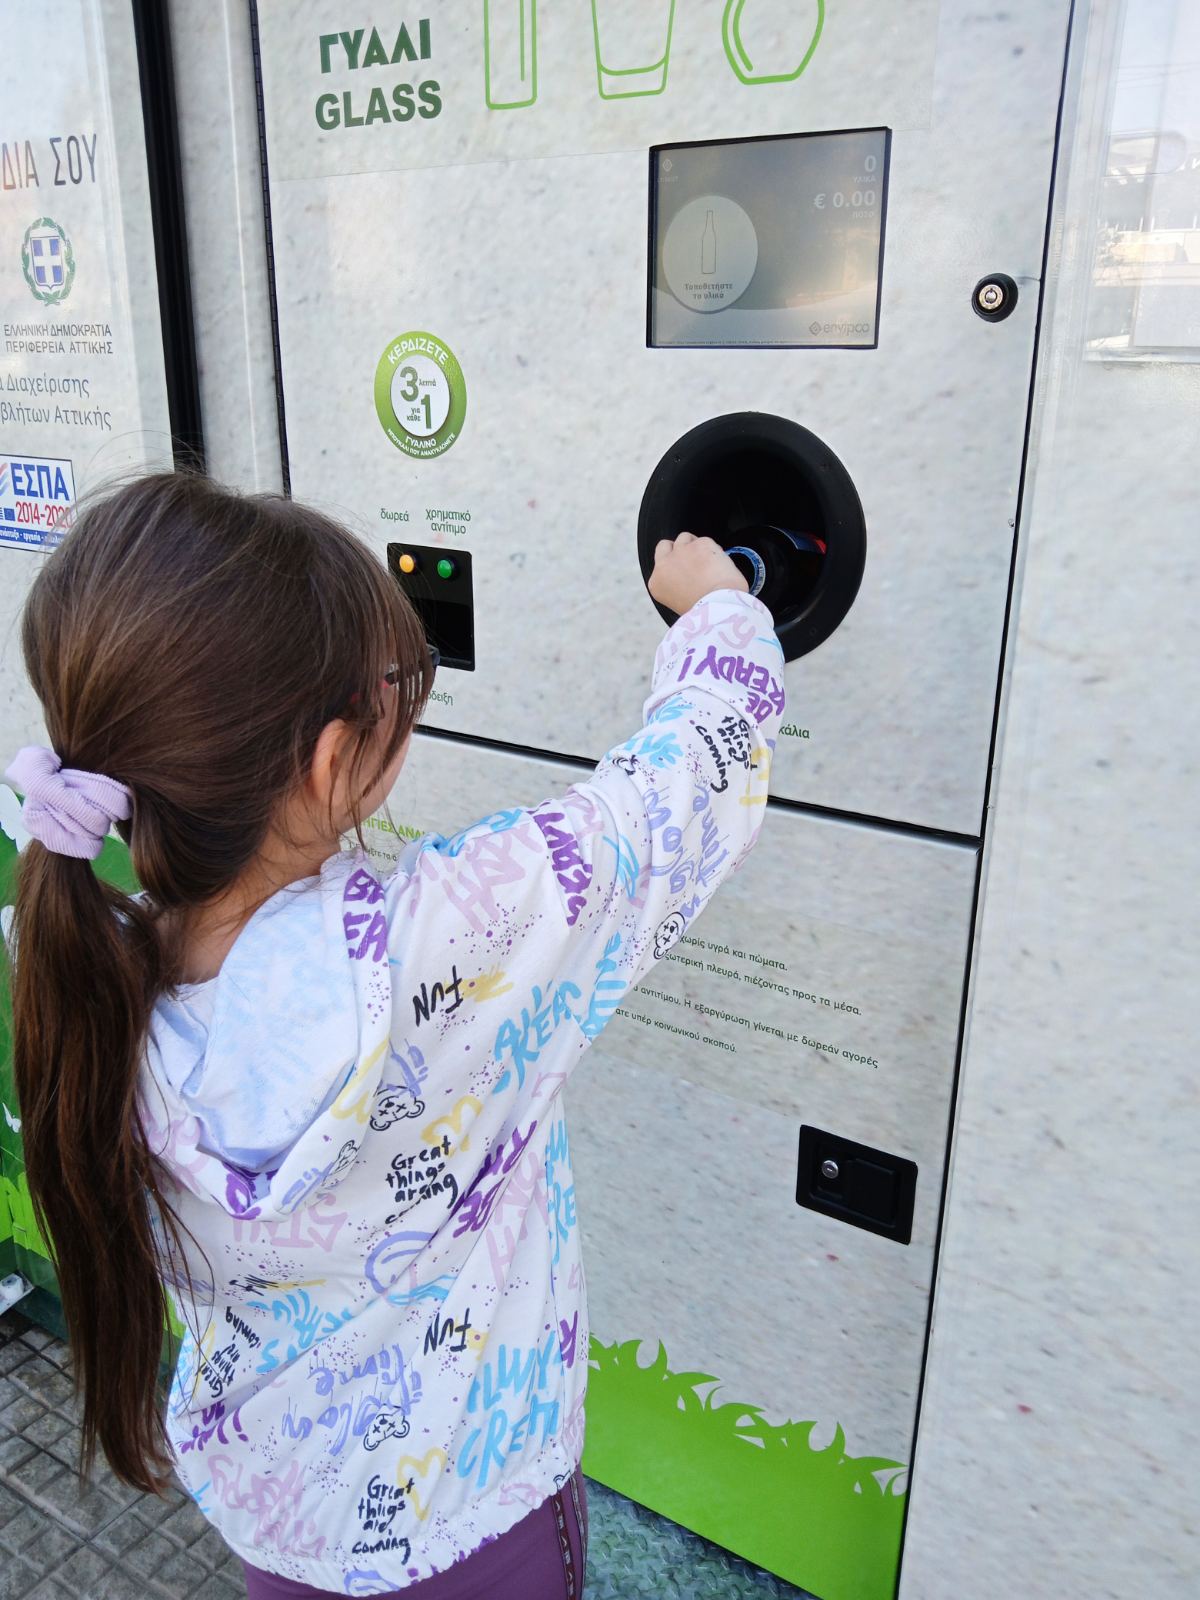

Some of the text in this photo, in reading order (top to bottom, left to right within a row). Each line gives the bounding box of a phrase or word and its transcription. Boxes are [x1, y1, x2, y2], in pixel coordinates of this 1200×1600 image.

[319, 18, 431, 74] ΓΥΑΛΙ
[315, 80, 442, 131] GLASS
[49, 133, 97, 186] ΣΟΥ
[864, 155, 876, 172] 0
[814, 190, 876, 210] € 0.00
[4, 323, 112, 337] ΕΛΛΗΝΙΚΗ ΔΗΜΟΚΡΑΤΙΑ
[823, 323, 870, 336] envipco
[6, 340, 113, 355] ΠΕΡΙΦΕΡΕΙΑ ΑΤΤΙΚΗΣ
[387, 337, 449, 365] ΚΕΡΔΙΖΕΤΕ
[7, 372, 90, 398] Διαχείρισης
[400, 366, 419, 402] 3
[54, 405, 112, 431] Αττικής
[421, 394, 432, 429] 1
[10, 463, 70, 501] ΕΣΠΑ
[425, 508, 471, 522] χρηματικό
[431, 521, 466, 535] αντίτιμο
[428, 690, 454, 706] δειξη
[779, 723, 810, 739] κάλια
[707, 943, 730, 955] υγρά
[732, 949, 746, 959] και
[749, 954, 788, 971] πώματα.
[706, 964, 741, 981] πλευρά,
[744, 974, 790, 996] πιέζοντας
[792, 989, 817, 1003] προς
[819, 997, 831, 1006] τα
[834, 1001, 862, 1016] μέσα.
[615, 1008, 738, 1053] ατε υπέρ κοινωνικού σκοπού.
[641, 986, 681, 1005] αντιτίμου.
[684, 999, 691, 1008] Η
[694, 1004, 750, 1028] εξαργύρωση
[753, 1021, 784, 1039] γίνεται
[787, 1032, 799, 1042] με
[801, 1036, 839, 1055] δωρεάν
[842, 1049, 879, 1069] αγορές
